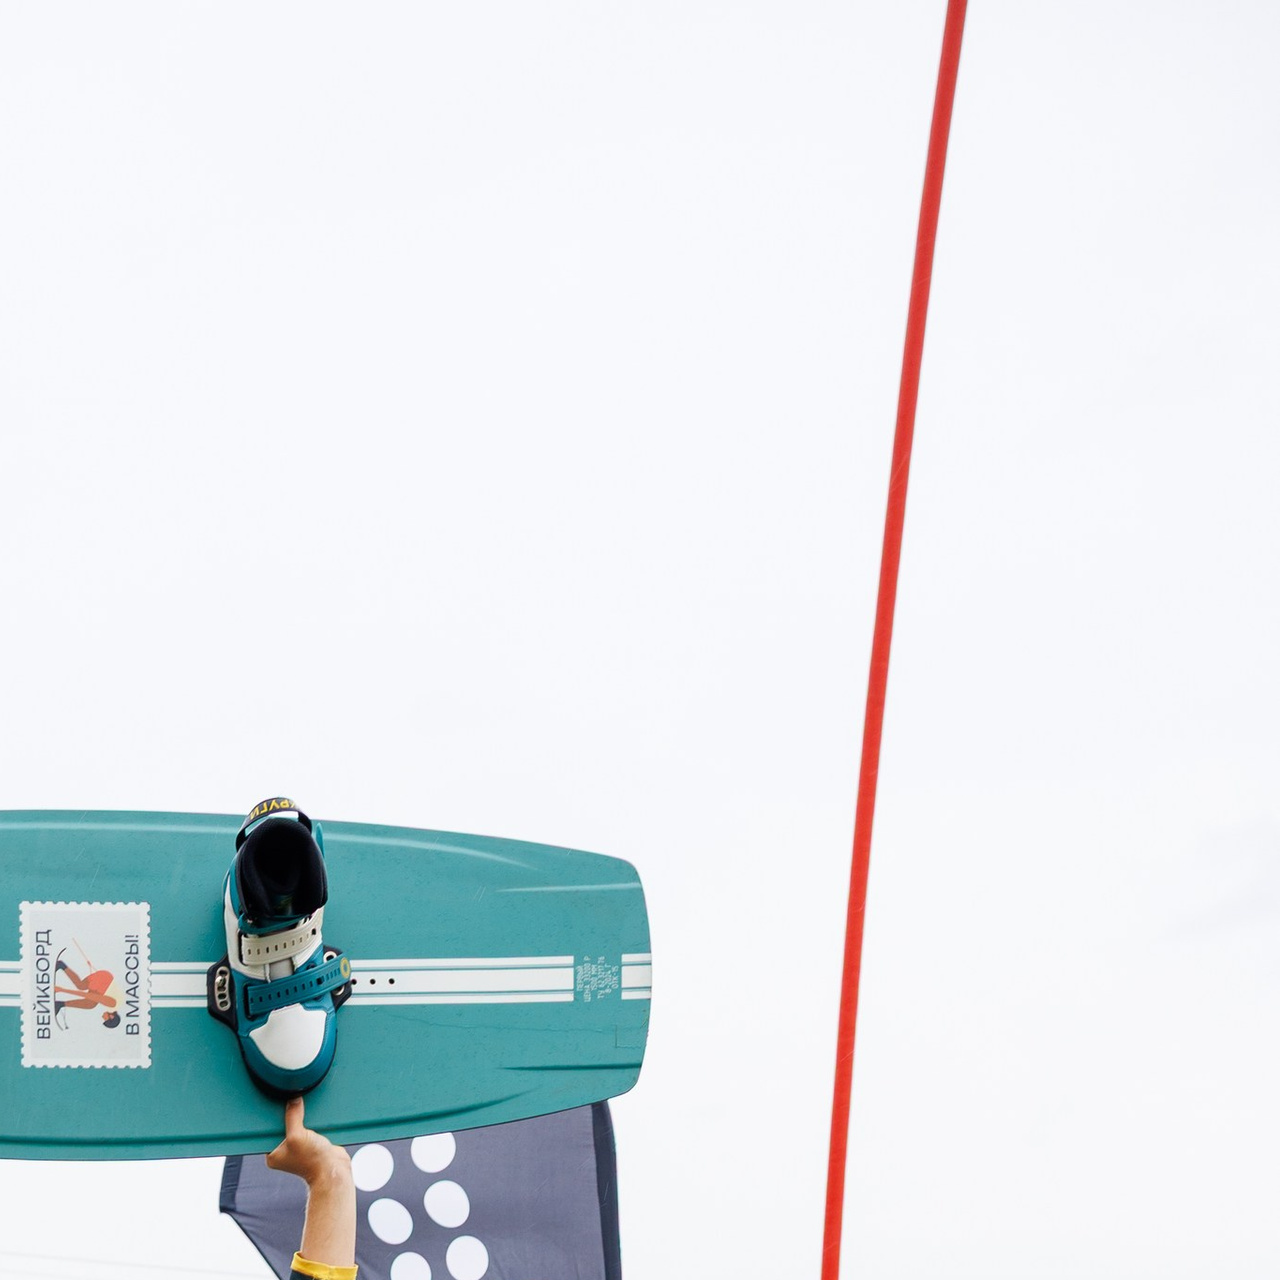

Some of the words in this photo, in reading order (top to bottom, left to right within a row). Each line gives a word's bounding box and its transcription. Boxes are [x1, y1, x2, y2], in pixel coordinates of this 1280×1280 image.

[32, 929, 52, 1039] ВЕЙКБОРД
[124, 934, 140, 1018] МАССЫ!
[126, 1023, 140, 1035] В
